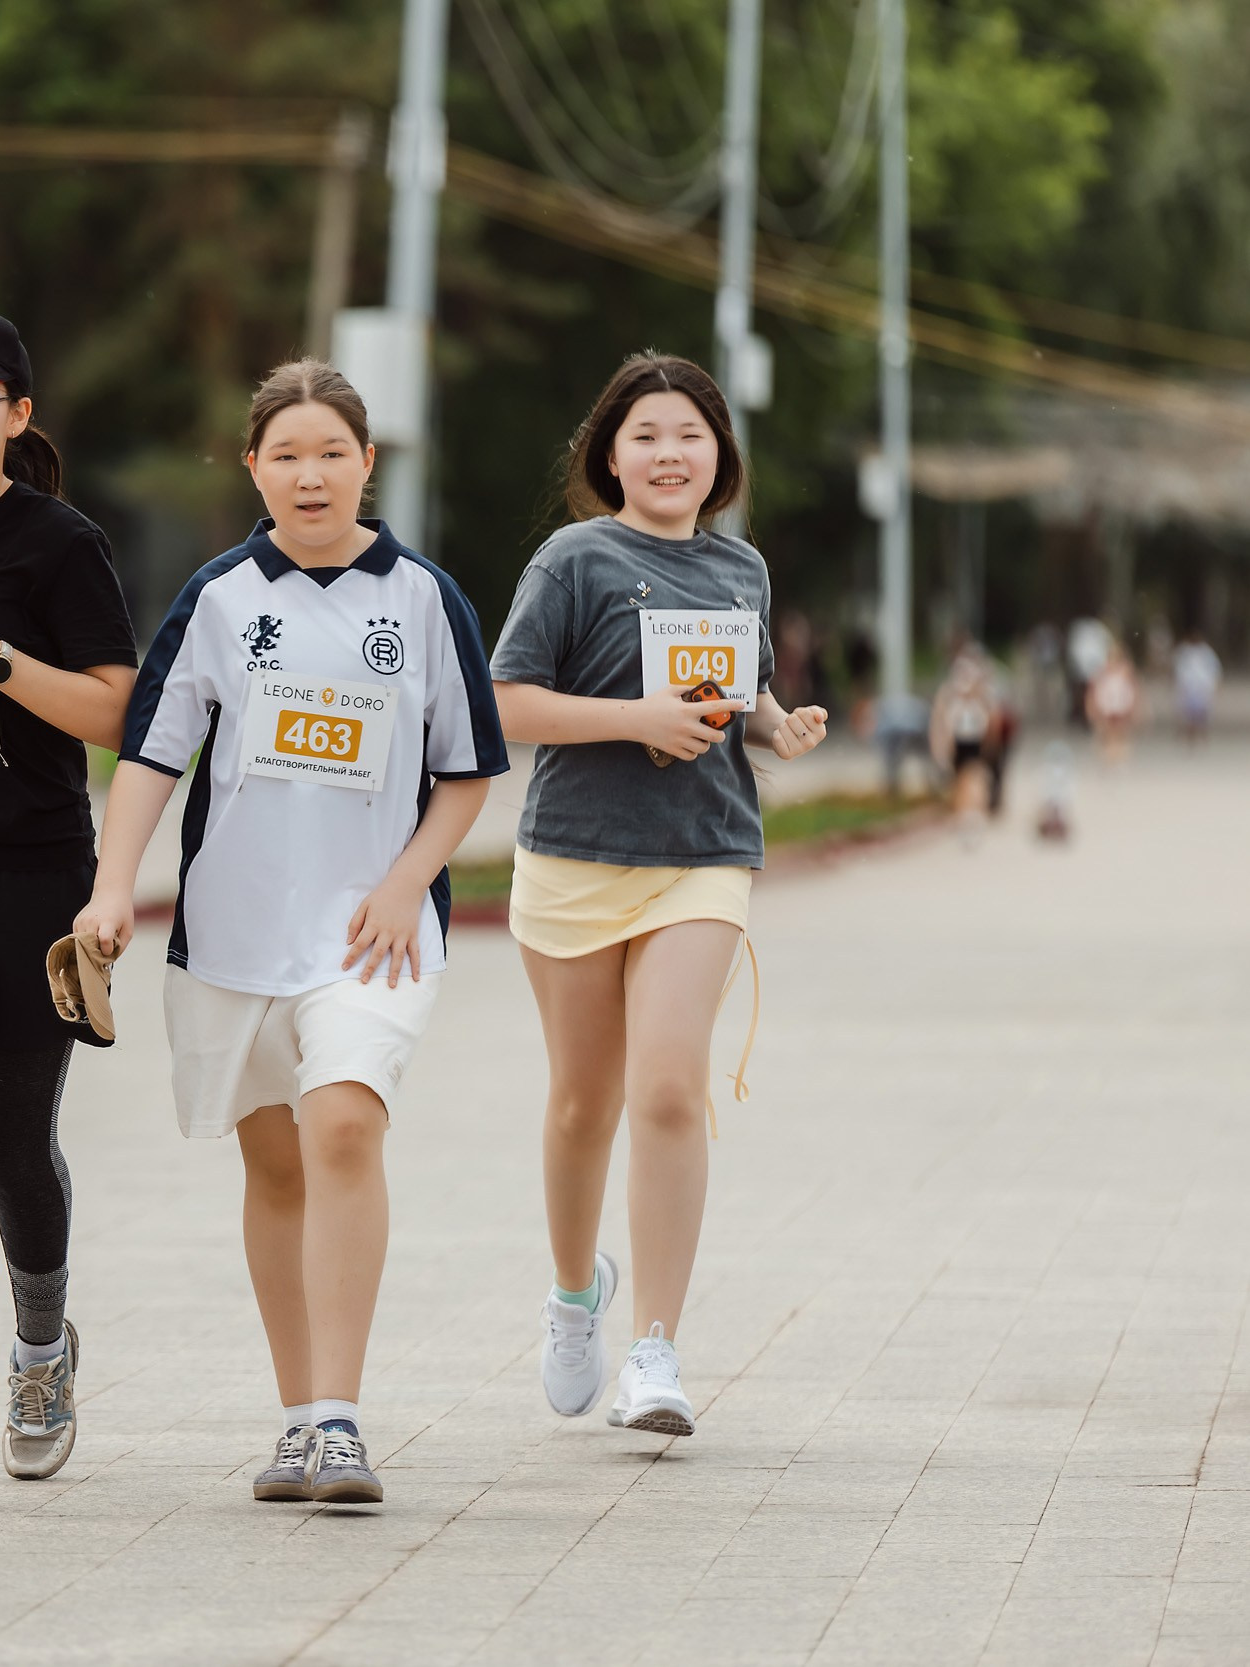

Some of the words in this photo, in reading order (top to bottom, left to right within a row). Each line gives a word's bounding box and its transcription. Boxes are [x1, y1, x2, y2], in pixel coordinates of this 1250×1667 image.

[652, 623, 694, 635] LEONE
[715, 624, 749, 636] D'ORO
[675, 650, 729, 682] 049
[263, 683, 315, 702] LEONE
[340, 694, 385, 711] D'ORO
[283, 717, 352, 756] 463
[254, 755, 347, 776] БЛАГОТВОРИТЕЛЬНЫЙ
[348, 767, 372, 779] ЗАБЕГ
